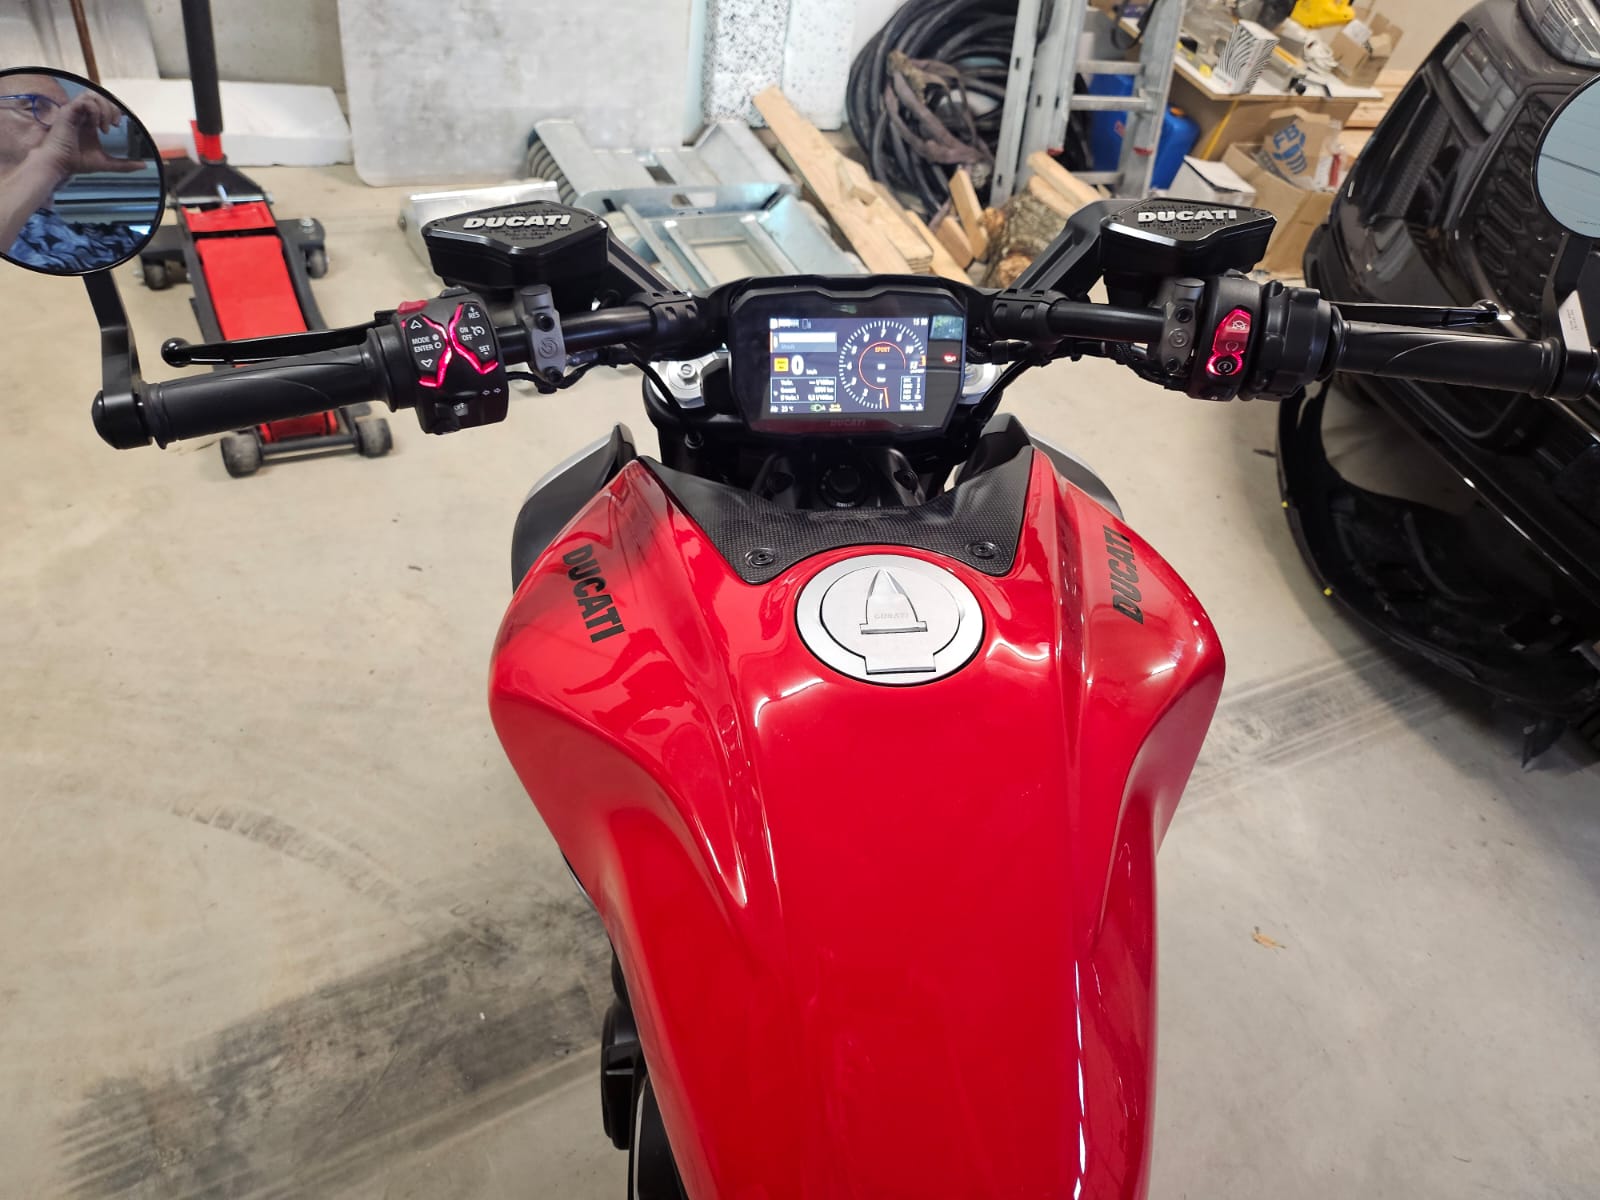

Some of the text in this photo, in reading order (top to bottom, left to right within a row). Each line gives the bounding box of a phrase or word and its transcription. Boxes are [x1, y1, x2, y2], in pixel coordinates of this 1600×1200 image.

[464, 214, 571, 229] DUCATI
[1137, 209, 1237, 224] DUCATI
[412, 335, 430, 344] MODE
[414, 344, 434, 353] ENTER
[791, 354, 804, 375] 0
[454, 403, 465, 411] OFF
[1102, 525, 1143, 624] DUCATI
[562, 544, 628, 643] DUCATI
